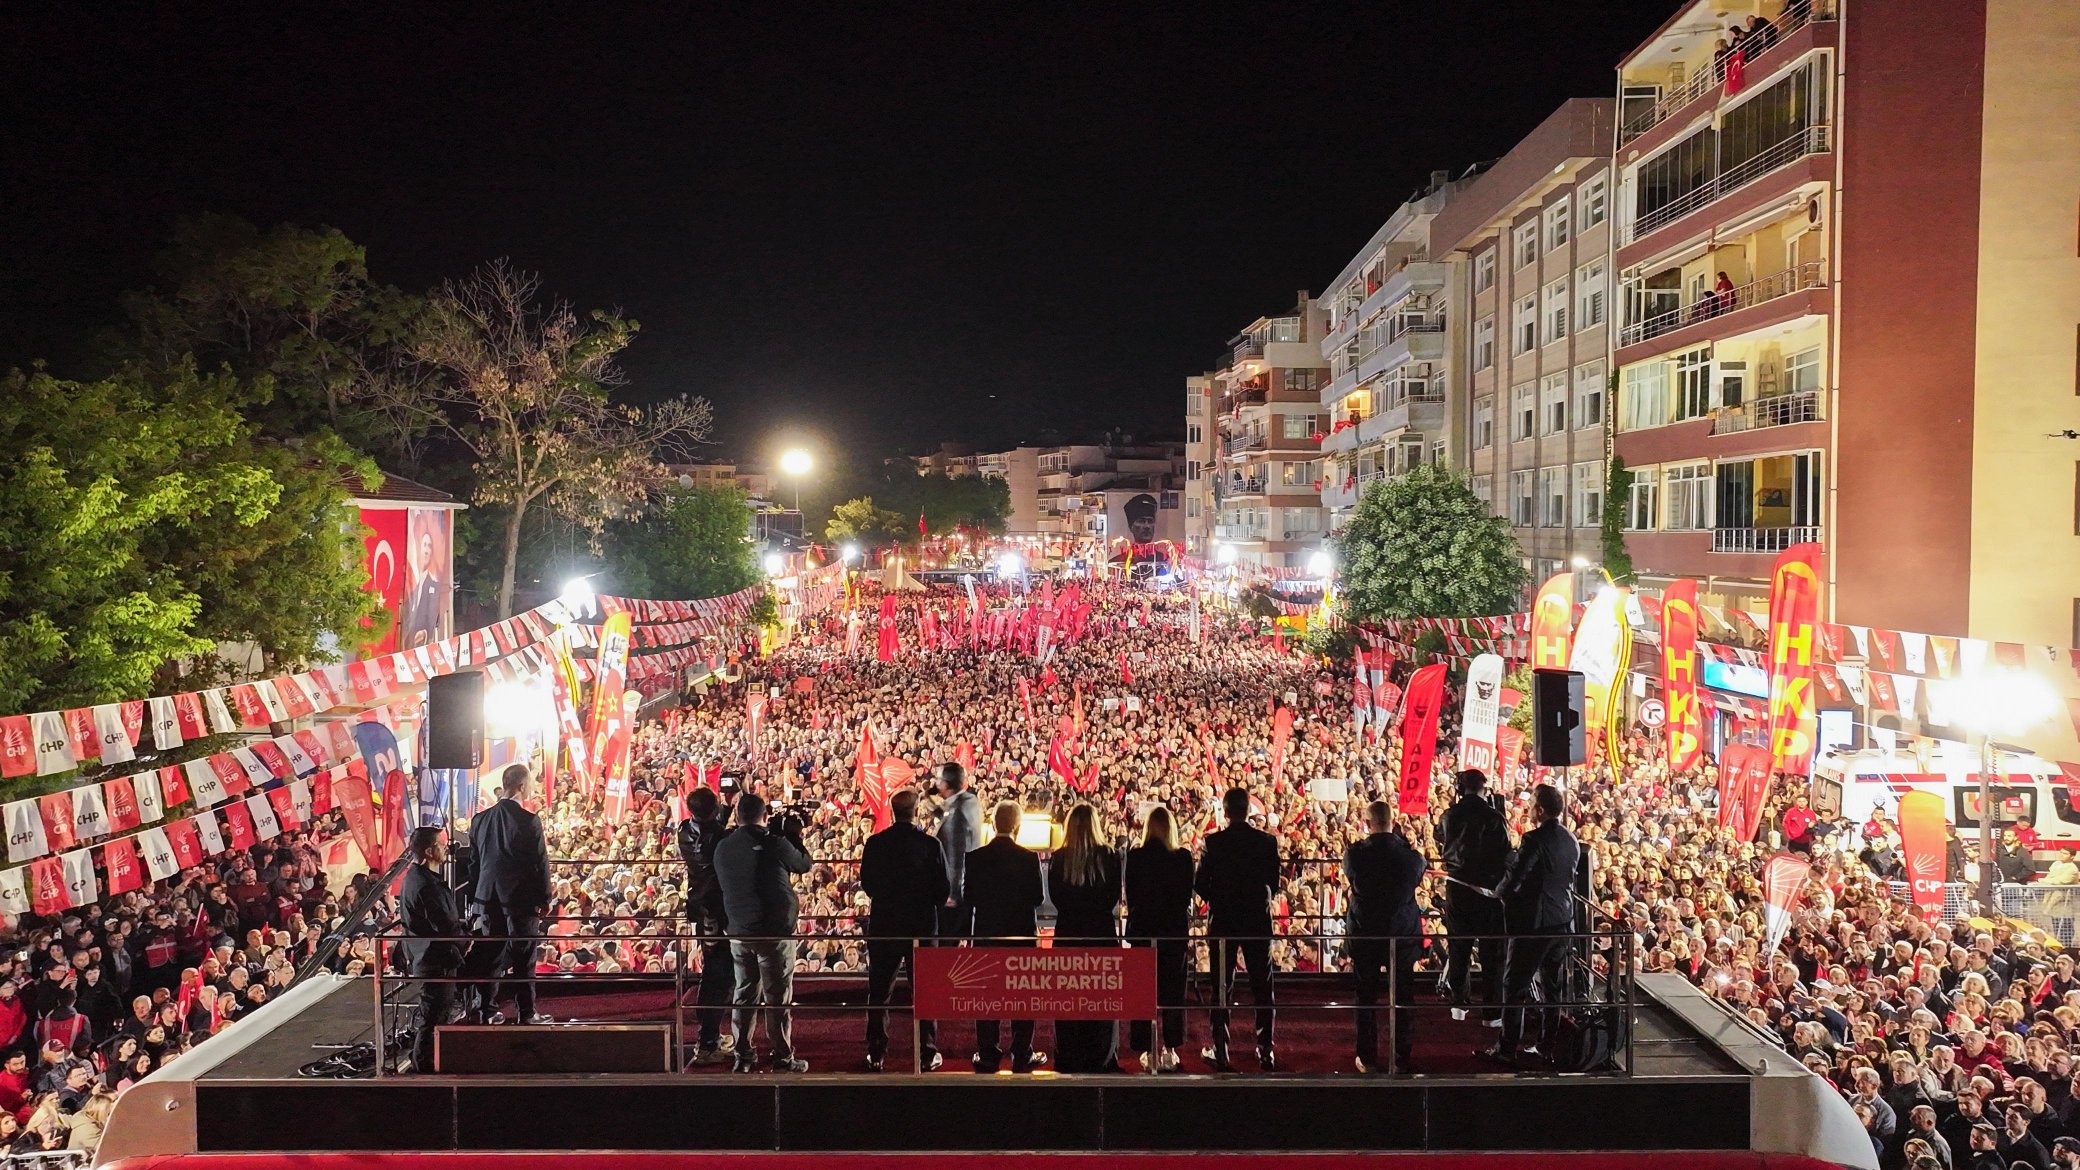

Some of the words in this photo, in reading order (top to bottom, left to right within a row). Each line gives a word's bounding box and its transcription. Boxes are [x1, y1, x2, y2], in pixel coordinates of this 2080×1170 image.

[1771, 622, 1814, 768] HKP
[1666, 646, 1698, 764] HKP
[128, 719, 141, 729] CH
[104, 732, 124, 744] CHP
[6, 745, 27, 757] CHP
[40, 739, 65, 753] CHP
[291, 753, 302, 764] HP
[1466, 744, 1490, 769] ADD
[1407, 743, 1422, 790] ADD
[223, 772, 239, 784] CHP
[198, 781, 217, 793] CHP
[77, 811, 100, 825] CHP
[112, 805, 132, 817] CHP
[282, 808, 292, 818] HP
[11, 831, 33, 845] CHP
[113, 865, 131, 878] CHP
[1914, 879, 1943, 893] CHP
[41, 887, 60, 900] CHP
[1005, 952, 1123, 971] CUMHURİYET
[1005, 975, 1051, 990] HALK
[1057, 971, 1123, 990] PARTİSİ
[949, 996, 1027, 1015] Türkiye'nin
[1030, 996, 1075, 1012] Birinci
[1079, 996, 1123, 1012] Partisi
